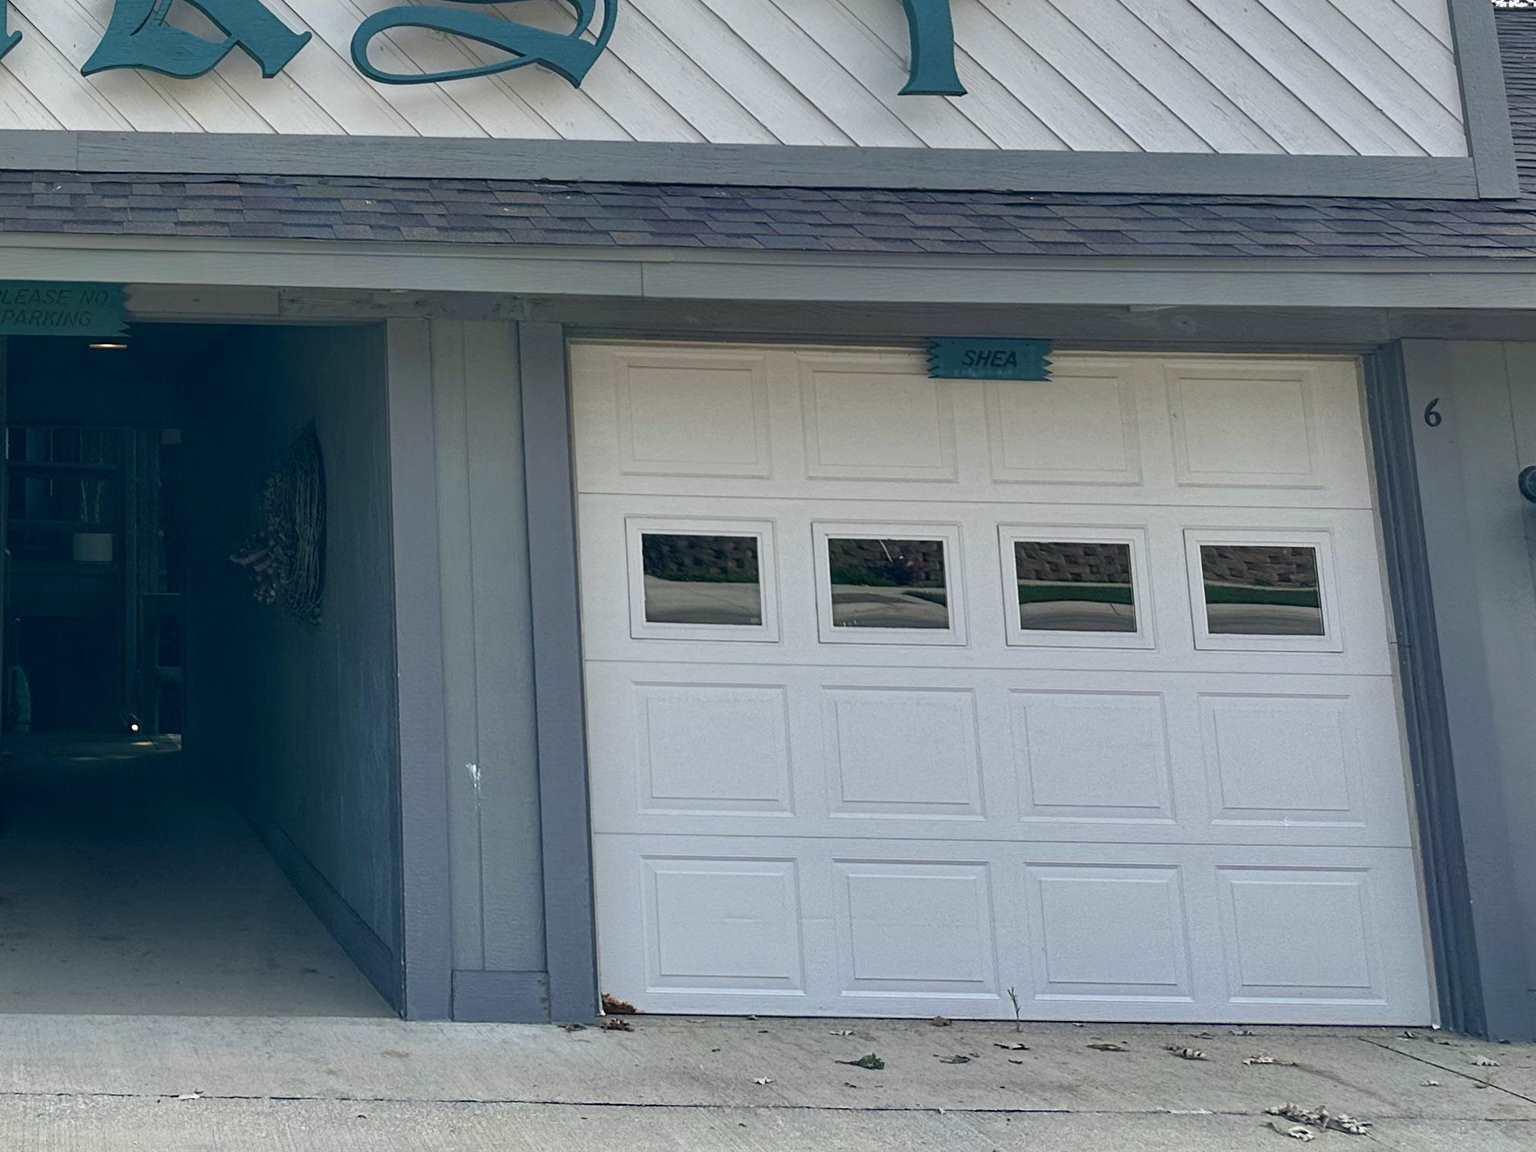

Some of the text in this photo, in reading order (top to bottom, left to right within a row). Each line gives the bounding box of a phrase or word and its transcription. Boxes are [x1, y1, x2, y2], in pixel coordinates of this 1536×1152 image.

[79, 288, 110, 306] NO
[0, 309, 93, 328] PARKING
[961, 349, 1018, 368] SHEA
[1424, 397, 1442, 427] 6
